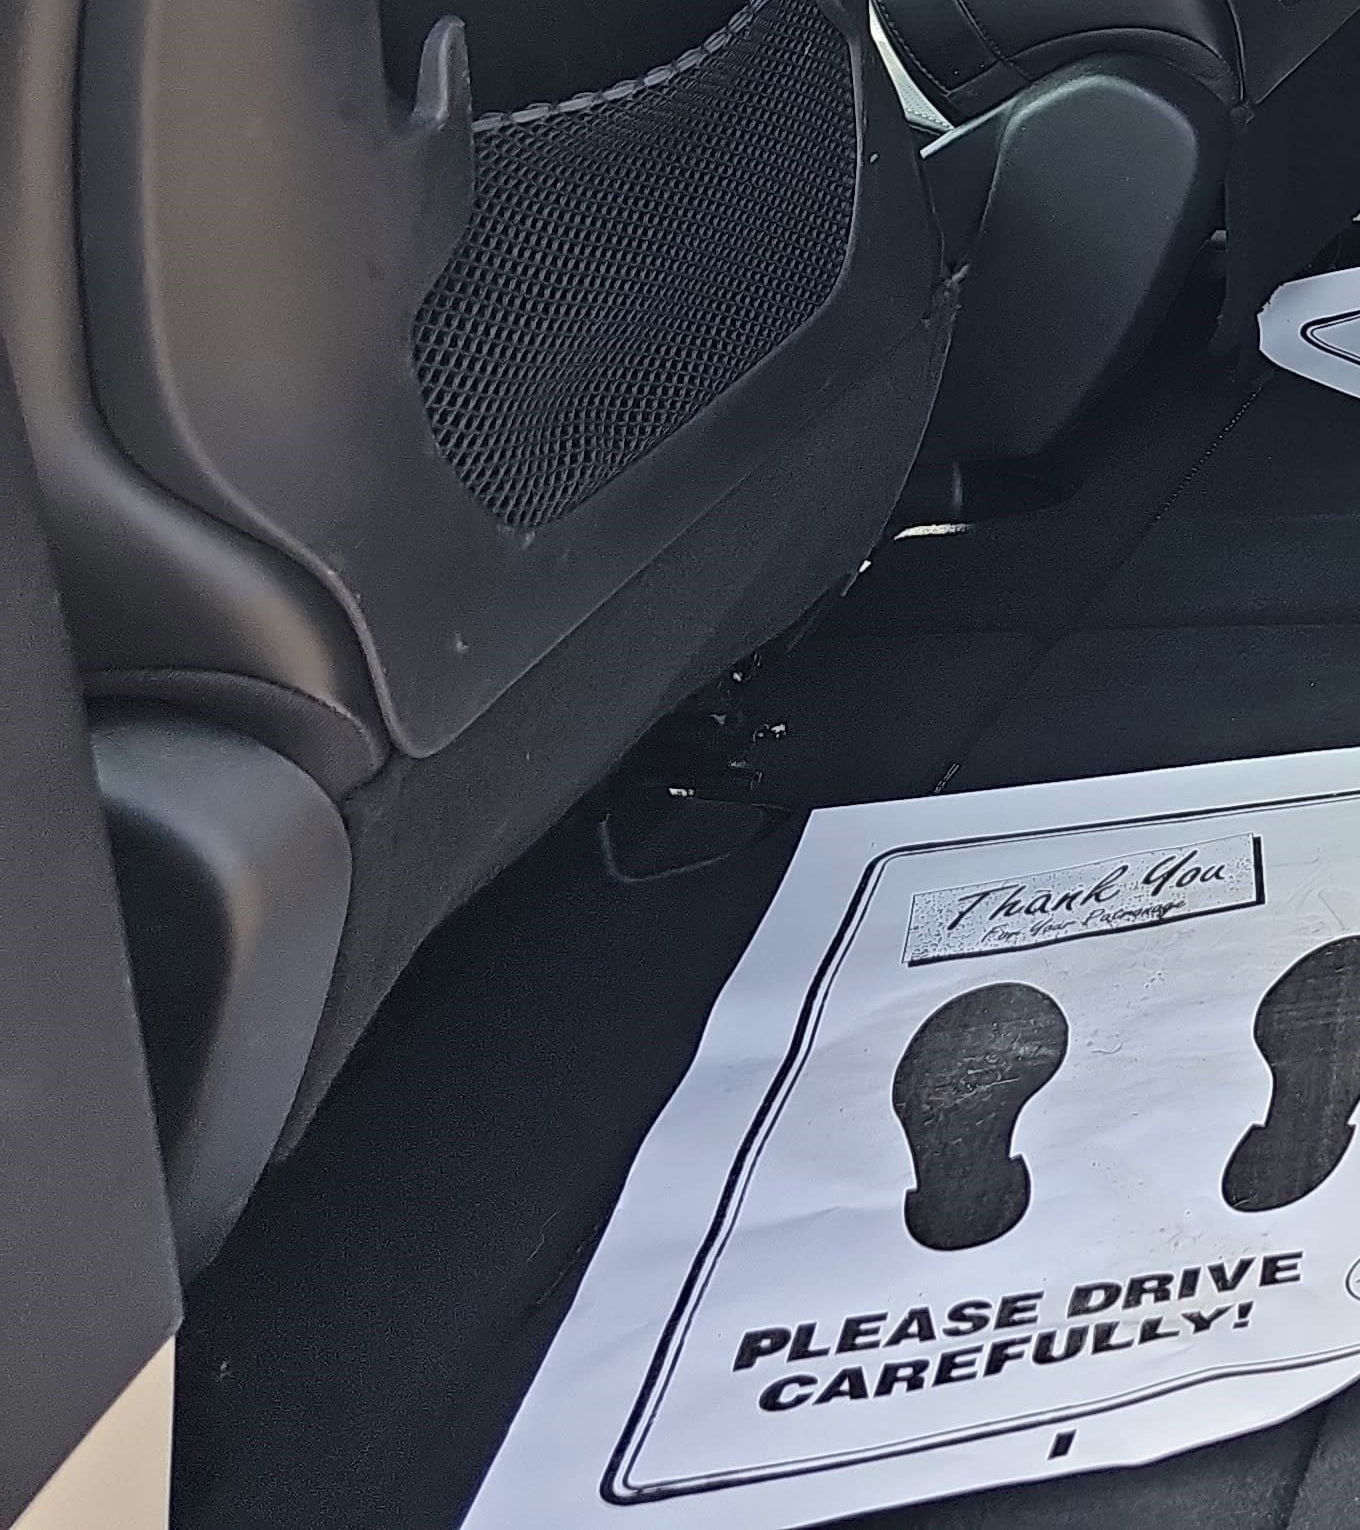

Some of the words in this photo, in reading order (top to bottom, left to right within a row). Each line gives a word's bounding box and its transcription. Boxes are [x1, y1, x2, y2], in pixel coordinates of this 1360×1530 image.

[947, 864, 1130, 930] Thank
[1143, 849, 1226, 897] You
[981, 923, 1020, 943] For
[1028, 915, 1078, 936] Your
[1086, 898, 1187, 931] Patronage
[732, 1290, 1045, 1372] PLEASE
[1067, 1251, 1303, 1319] DRIVE
[757, 1301, 1255, 1412] CAREFULLY!
